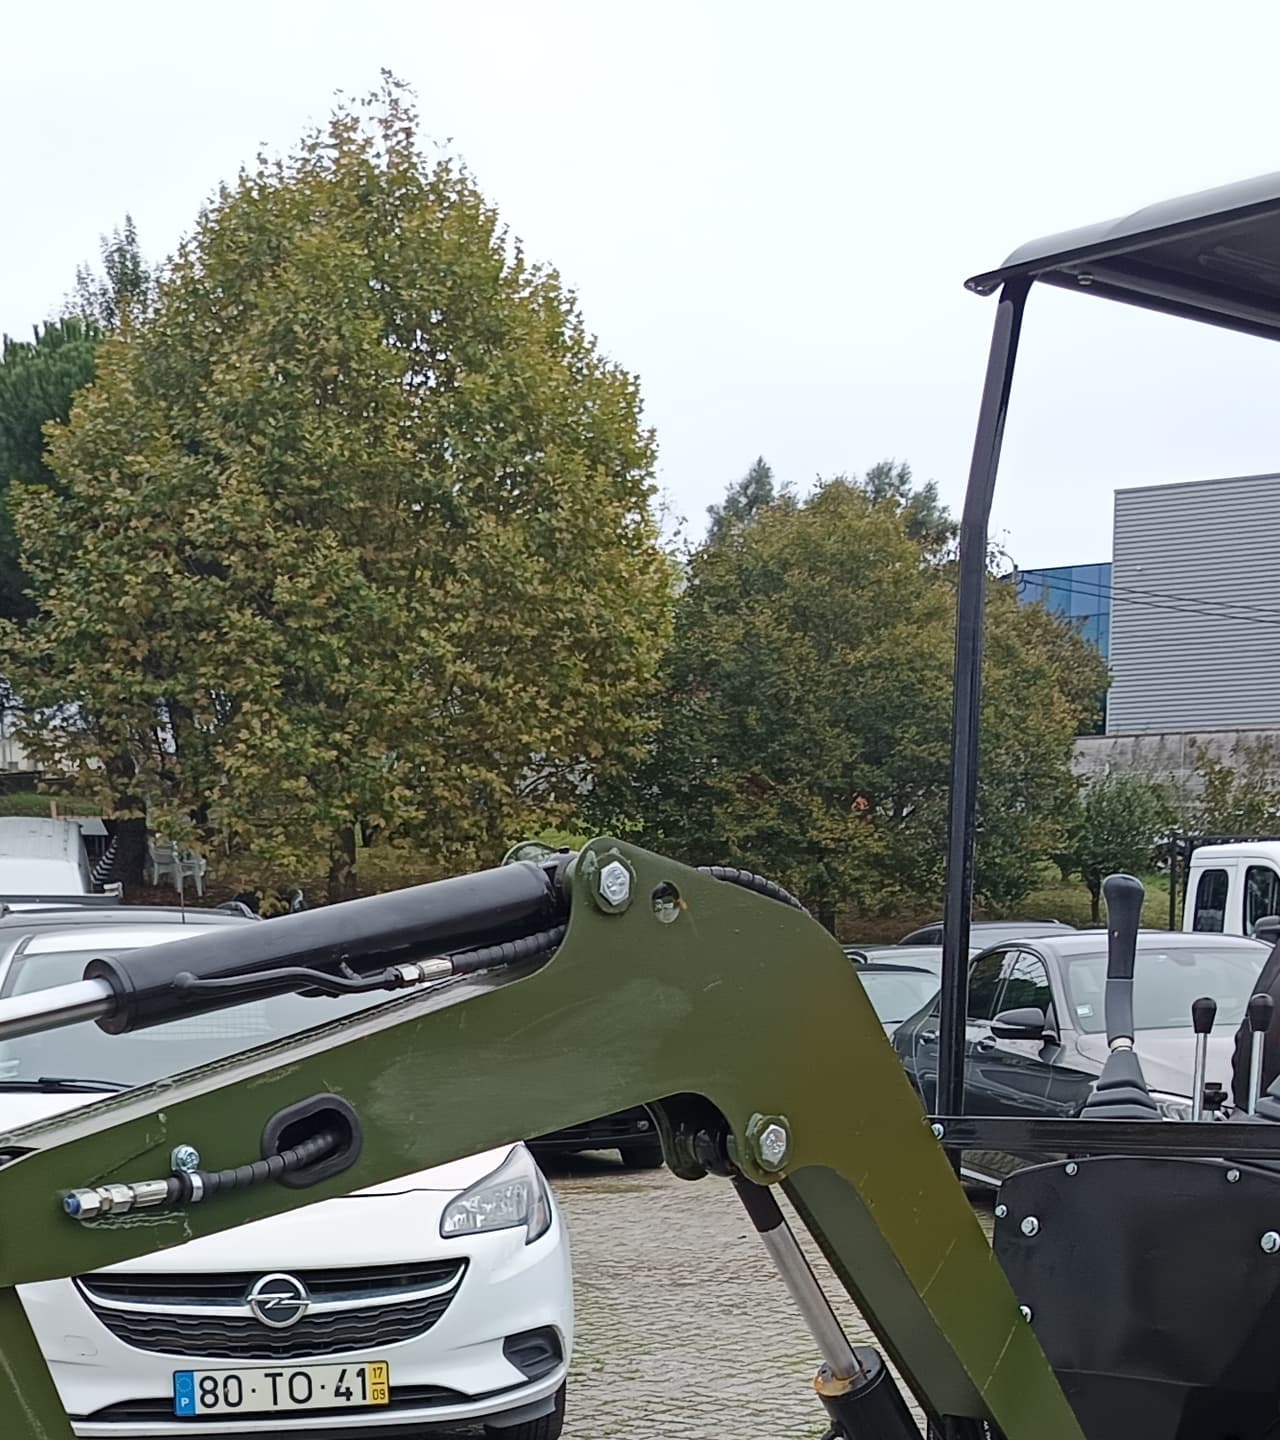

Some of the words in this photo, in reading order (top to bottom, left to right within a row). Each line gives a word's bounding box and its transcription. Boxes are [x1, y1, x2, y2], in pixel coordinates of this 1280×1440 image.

[372, 1367, 384, 1378] 17
[372, 1389, 386, 1401] 09
[181, 1398, 190, 1407] P
